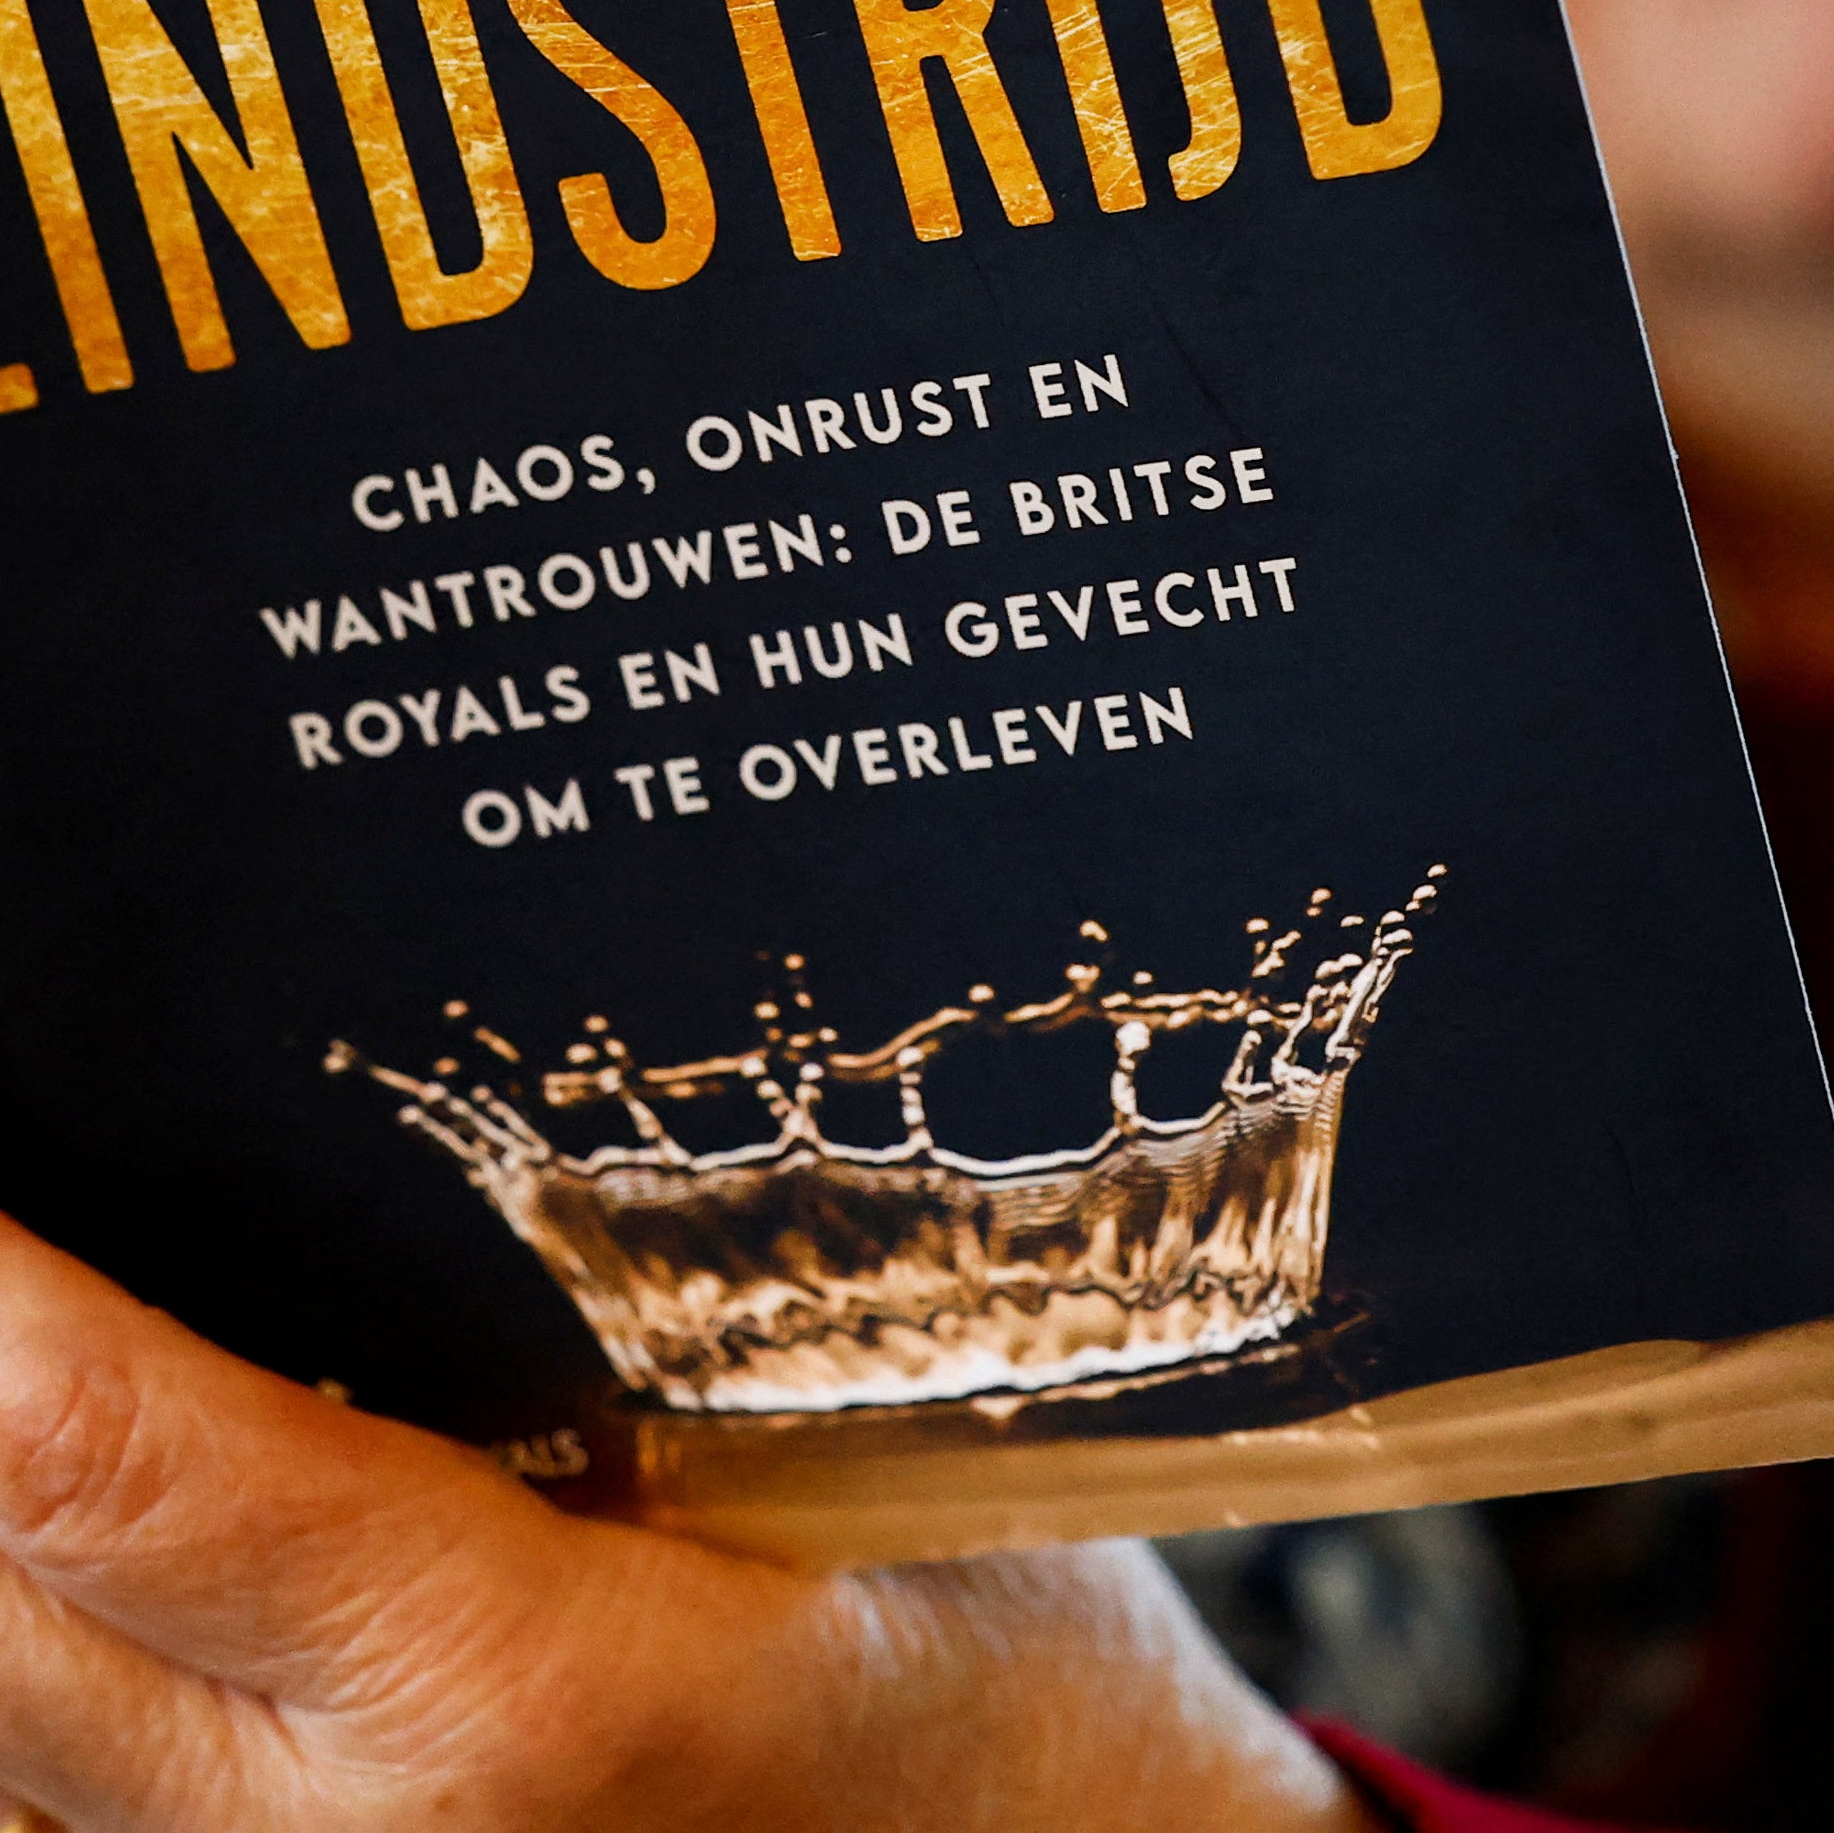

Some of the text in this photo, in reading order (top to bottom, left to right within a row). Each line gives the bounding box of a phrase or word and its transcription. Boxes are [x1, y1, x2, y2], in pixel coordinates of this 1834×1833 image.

[352, 354, 1129, 531] CHAOS, ONRUST EN
[261, 447, 1274, 658] WANTROUWEN: DE BRITSE
[290, 557, 1298, 768] ROYALS EN HUN GEVECHT
[462, 687, 1193, 847] OM TE OVERLEVEN
